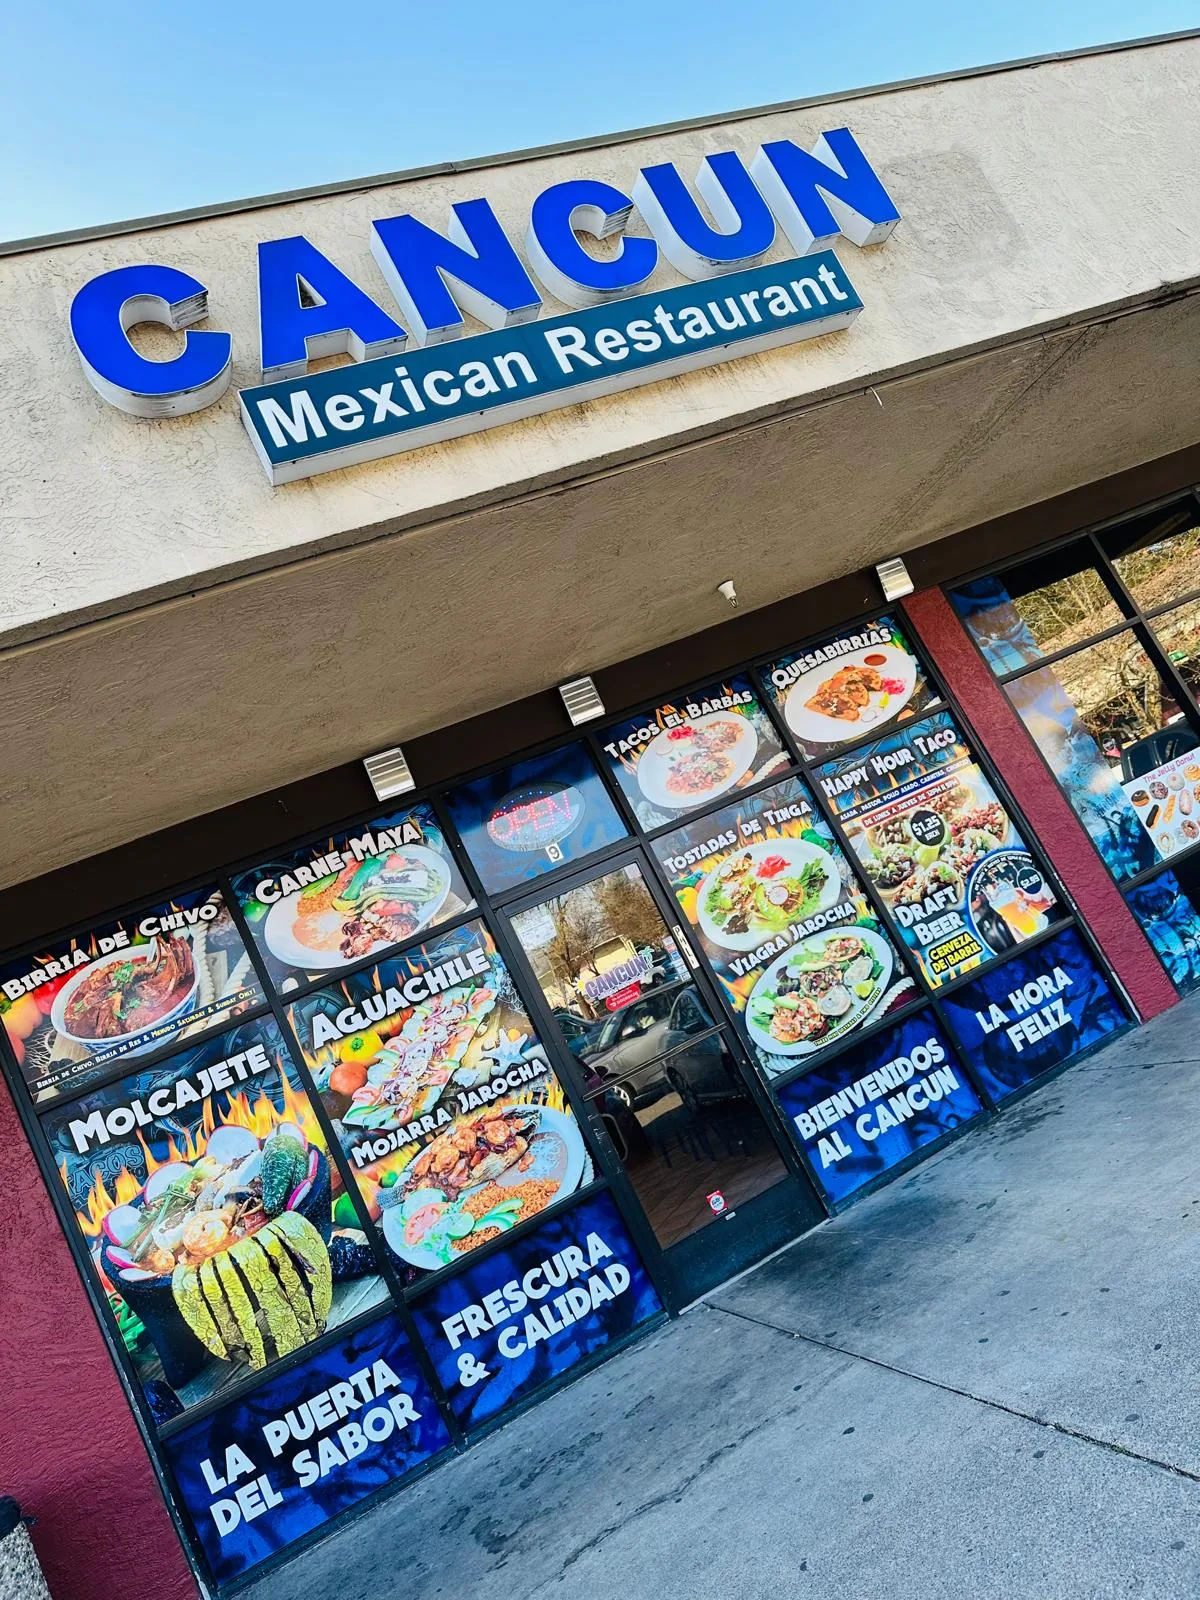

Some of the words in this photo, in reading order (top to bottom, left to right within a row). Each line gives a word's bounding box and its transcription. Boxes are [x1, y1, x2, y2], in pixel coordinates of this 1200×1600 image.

[70, 126, 901, 402] CANCUN
[257, 349, 538, 449] Mexican
[545, 263, 848, 376] Restaurant
[771, 628, 892, 691] QUESABIRRIAS
[604, 719, 661, 759] TACOS
[663, 711, 685, 729] EL
[685, 690, 753, 721] BARBAS
[819, 770, 870, 799] HAPPY
[870, 748, 915, 776] HOUR
[914, 728, 957, 757] TACO
[1142, 773, 1157, 784] The
[1157, 762, 1177, 778] Jelly
[490, 791, 573, 840] OPEN
[548, 845, 560, 860] 9
[663, 830, 738, 875] TOSTADAS
[740, 818, 762, 836] DE
[763, 800, 813, 825] TINGA
[911, 814, 941, 836] $1.25
[254, 849, 345, 904] CARNE
[349, 821, 422, 863] MAYA
[728, 936, 788, 977] VIAGRA
[787, 901, 856, 942] JAROCHA
[894, 885, 960, 928] DRAFT
[912, 910, 965, 946] BEER
[1, 949, 91, 1001] BIRRIA
[98, 930, 130, 953] DE
[139, 903, 218, 938] CHIVO
[929, 931, 974, 961] CERVEZA
[931, 958, 949, 974] DE
[947, 941, 982, 968] BARRIL
[311, 946, 491, 1050] AGUACHILE
[974, 1003, 1009, 1035] LA
[1007, 965, 1074, 1013] HORA
[1006, 997, 1073, 1054] FELIZ
[36, 1075, 60, 1089] BIRRIA
[61, 1070, 70, 1078] DE
[94, 1049, 118, 1064] BIRRIA
[119, 1044, 128, 1053] DE
[128, 1038, 142, 1049] RES
[68, 1043, 271, 1154] MOLCAJETE
[793, 1037, 945, 1141] BIENVENIDOS
[350, 1107, 453, 1169] MOJARRA
[456, 1057, 548, 1114] JAROCHA
[816, 1130, 853, 1169] AL
[855, 1065, 960, 1142] CANCUN
[441, 1231, 614, 1351] FRESCURA
[457, 1353, 492, 1388] &
[497, 1262, 631, 1360] CALIDAD
[200, 1442, 257, 1496] LA
[262, 1357, 403, 1458] PUERTA
[209, 1474, 284, 1538] DEL
[291, 1392, 422, 1489] SABOR
